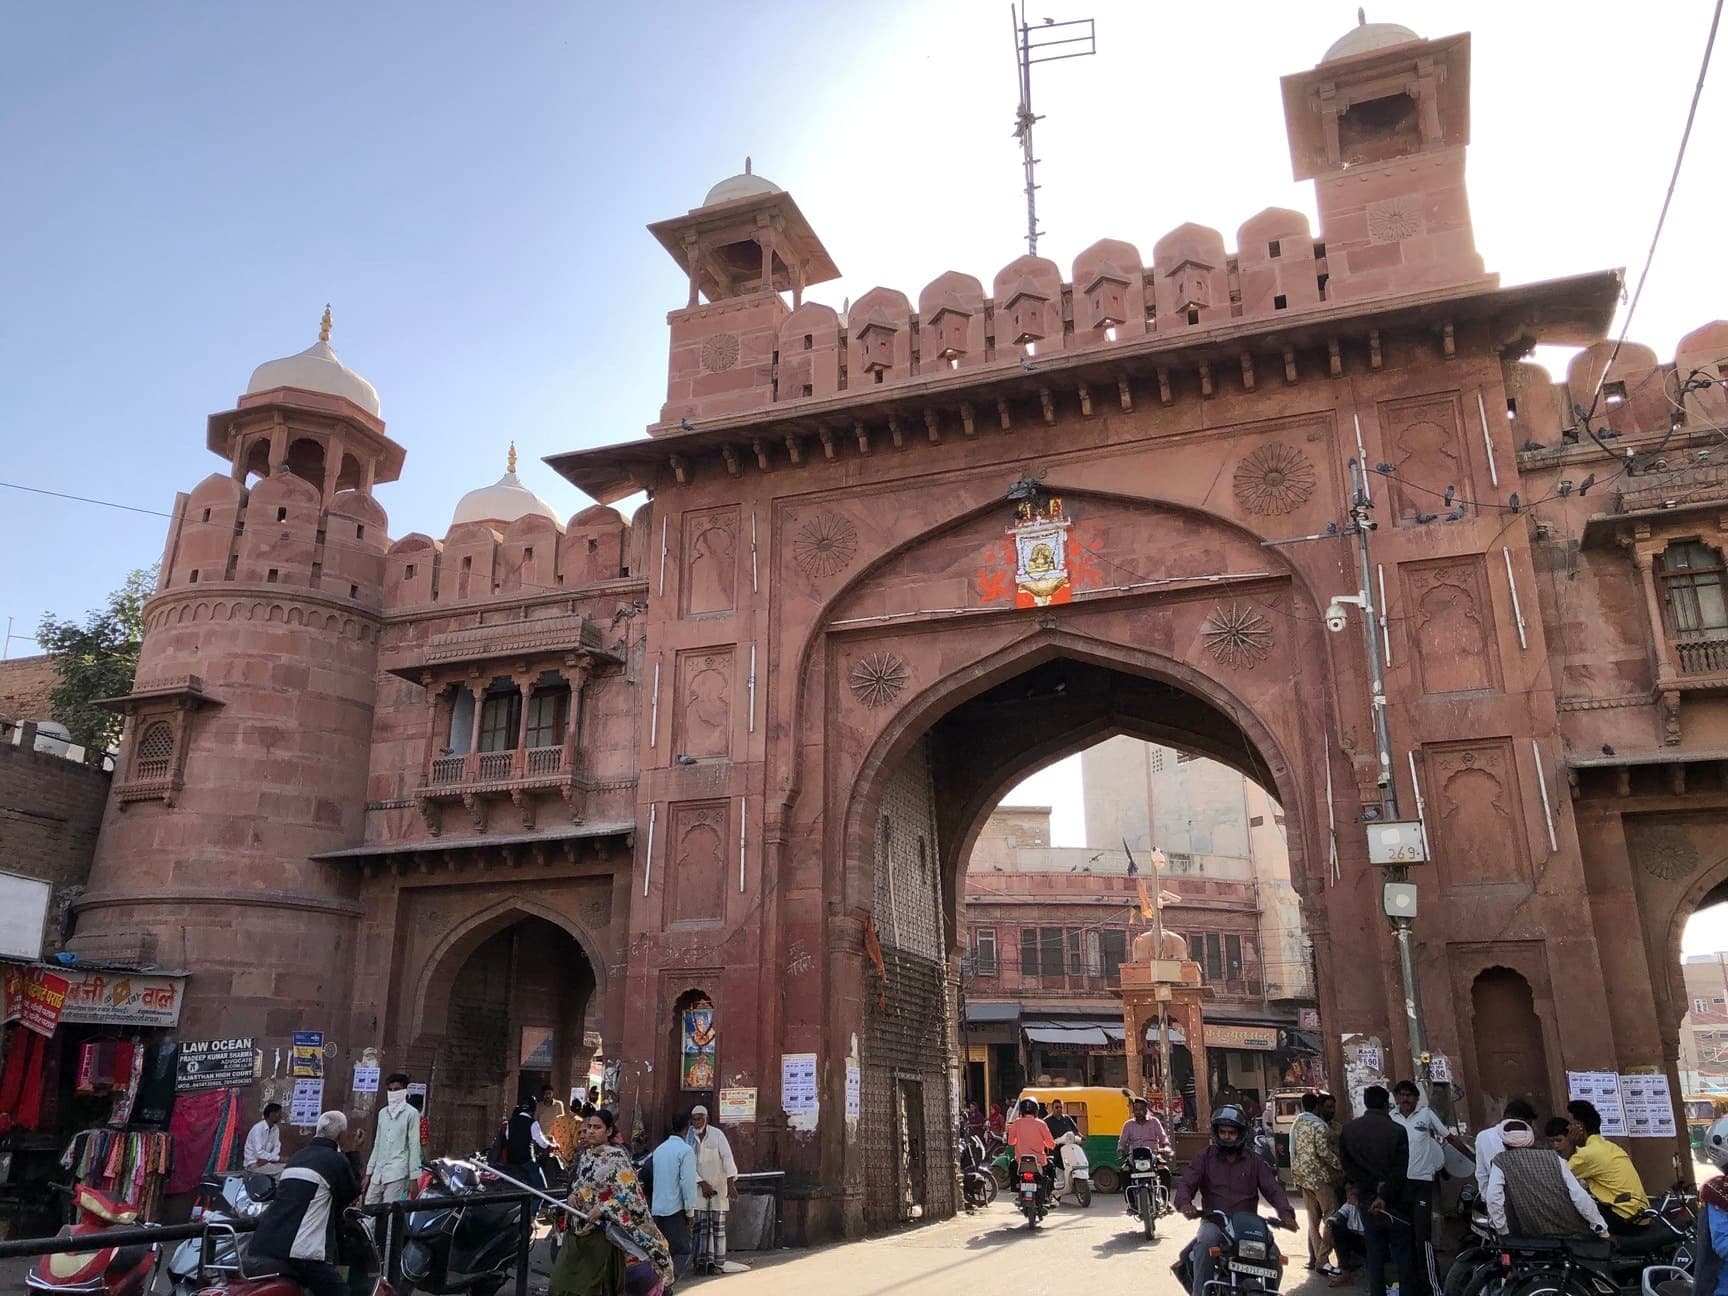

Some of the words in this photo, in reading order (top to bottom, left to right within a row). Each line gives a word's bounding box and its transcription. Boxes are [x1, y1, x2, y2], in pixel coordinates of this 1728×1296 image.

[1387, 846, 1416, 859] 269
[183, 1042, 209, 1053] LAW
[212, 1039, 252, 1051] OCEAN
[180, 1054, 206, 1063] PRADEEP
[207, 1052, 228, 1060] KUMAR
[229, 1050, 253, 1059] SHARMA
[221, 1057, 253, 1065] ADVOCATE
[178, 1073, 214, 1081] RAJASTHAN
